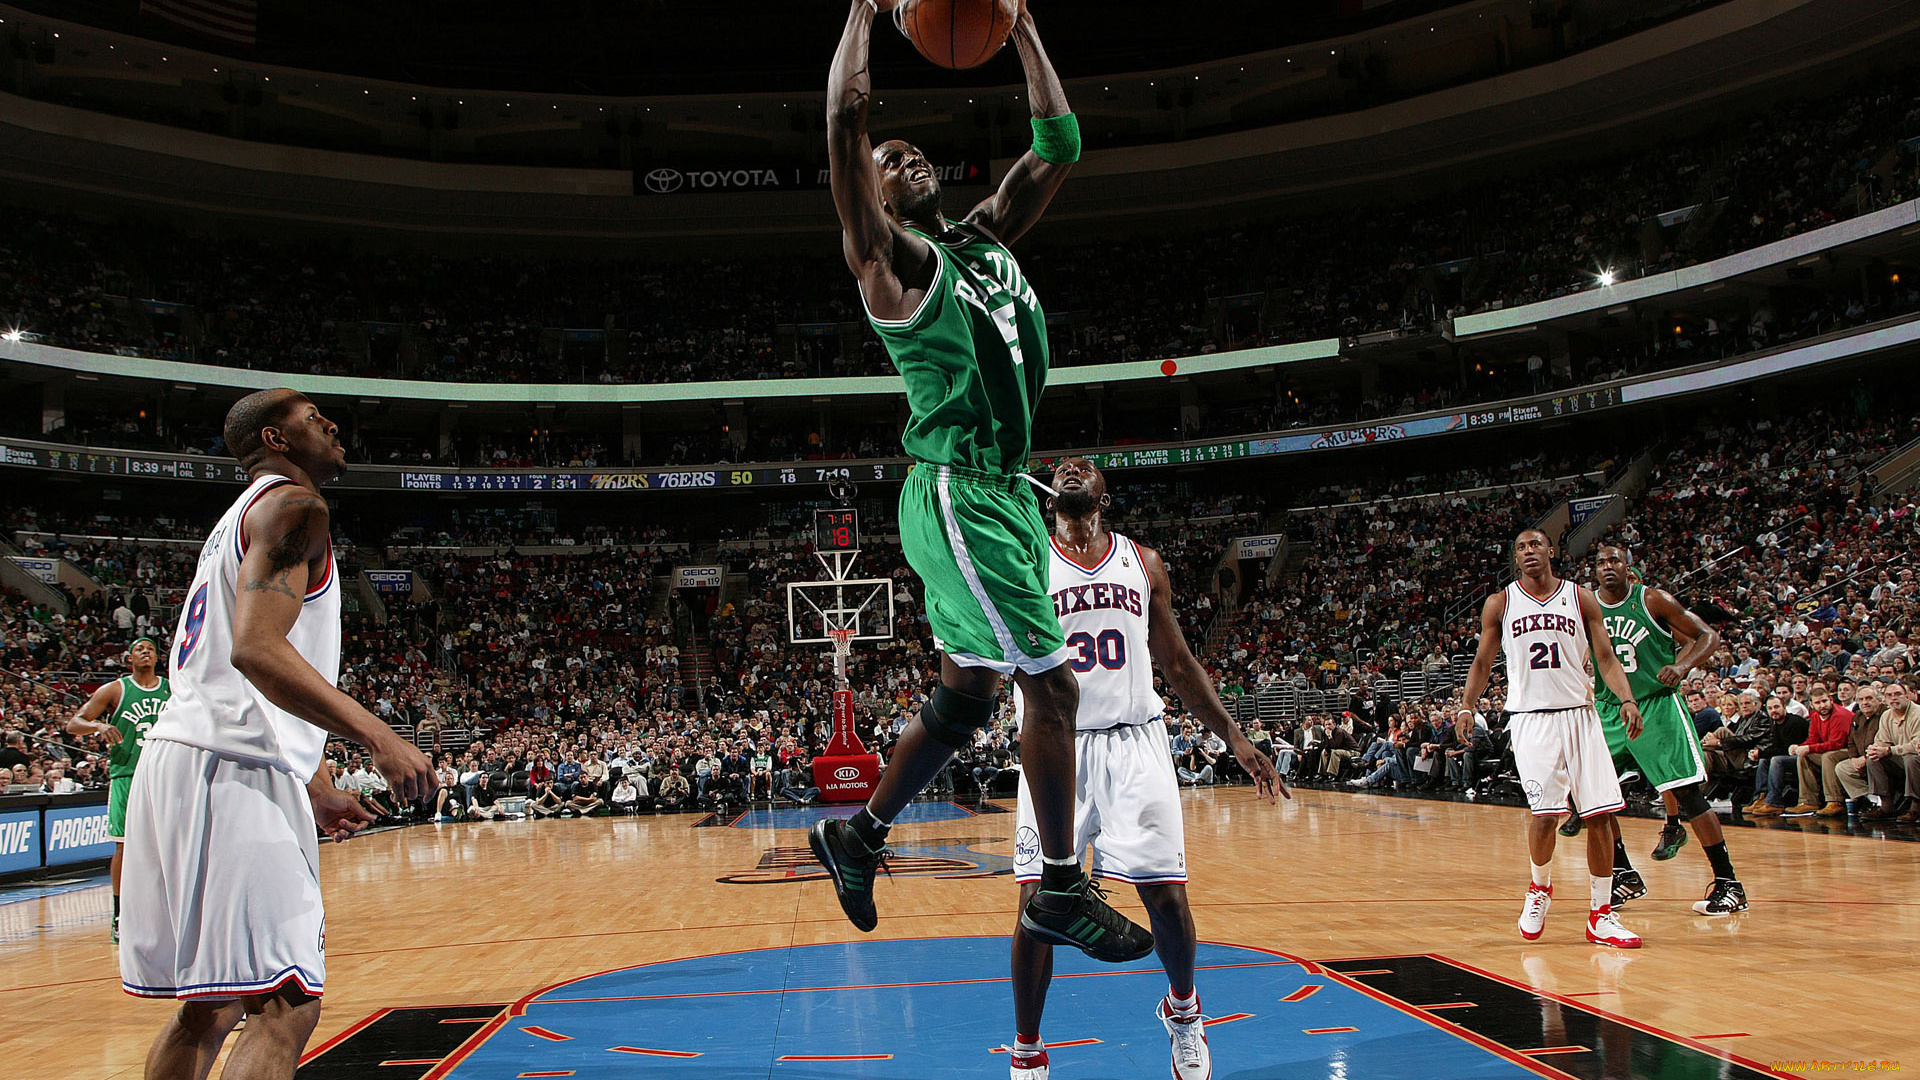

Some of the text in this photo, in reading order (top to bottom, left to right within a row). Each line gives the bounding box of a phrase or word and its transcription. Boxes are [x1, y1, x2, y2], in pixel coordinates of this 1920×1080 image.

[687, 169, 779, 188] TOYOTA
[954, 251, 1037, 316] BSTON
[991, 301, 1024, 366] 5
[1513, 406, 1538, 415] Sixers
[1470, 412, 1509, 426] 8:39 PM
[1513, 411, 1542, 421] Celtics
[1317, 428, 1398, 449] SMUCKR'S
[6, 449, 34, 458] Sixers
[1134, 450, 1168, 458] PLAYER
[6, 456, 37, 465] Celtics
[1109, 457, 1117, 467] 4
[1122, 457, 1128, 466] 1
[1135, 457, 1168, 466] POINTS
[132, 461, 159, 473] 8:39
[180, 462, 193, 470] ATL
[180, 470, 195, 478] ORL
[406, 474, 441, 482] PLAYER
[731, 471, 753, 484] 50
[780, 473, 797, 483] 18
[816, 468, 850, 481] 7:19
[875, 470, 883, 480] 3
[534, 480, 542, 489] 2
[556, 480, 565, 489] 3
[570, 480, 577, 489] 1
[658, 471, 716, 488] 76ERS
[407, 481, 441, 489] POINTS
[828, 513, 852, 525] 7:19
[1573, 513, 1586, 523] 117
[833, 527, 849, 547] 18
[1243, 538, 1277, 548] GEICO
[1241, 549, 1254, 558] 118
[17, 561, 52, 570] EICO
[370, 573, 406, 581] GEICO
[682, 568, 716, 576] GEICO
[42, 573, 57, 582] 121
[680, 577, 720, 586] 120 119
[395, 583, 411, 591] 120
[1052, 583, 1142, 618] SIXERS
[177, 581, 209, 671] 9
[1512, 614, 1576, 638] SIXERS
[1603, 616, 1650, 647] STON
[1066, 629, 1126, 673] 30
[1529, 642, 1561, 670] 21
[1614, 644, 1638, 673] 3
[839, 770, 855, 778] KIA
